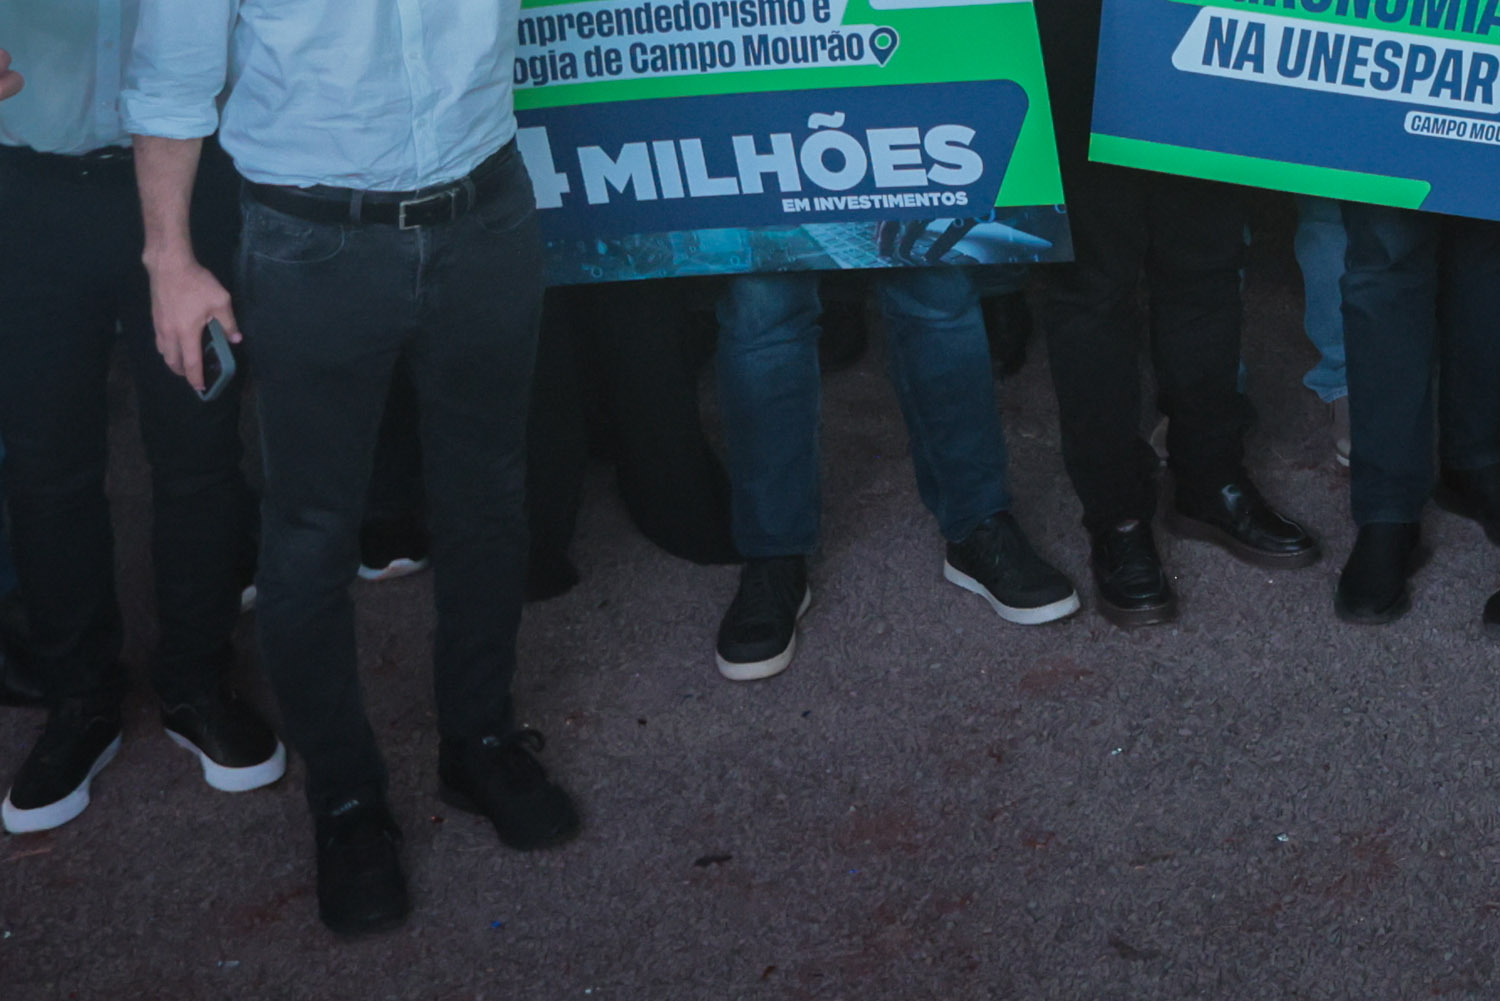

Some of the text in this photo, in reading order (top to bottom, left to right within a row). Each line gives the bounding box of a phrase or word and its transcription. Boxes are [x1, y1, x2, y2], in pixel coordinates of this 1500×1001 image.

[514, 30, 865, 86] ogia de Campo Mourão
[1202, 16, 1500, 105] NA UNESPAR
[1411, 114, 1467, 138] CAMPO
[577, 111, 984, 205] MILHÕES
[782, 191, 968, 213] EM INVESTIMENTOS
